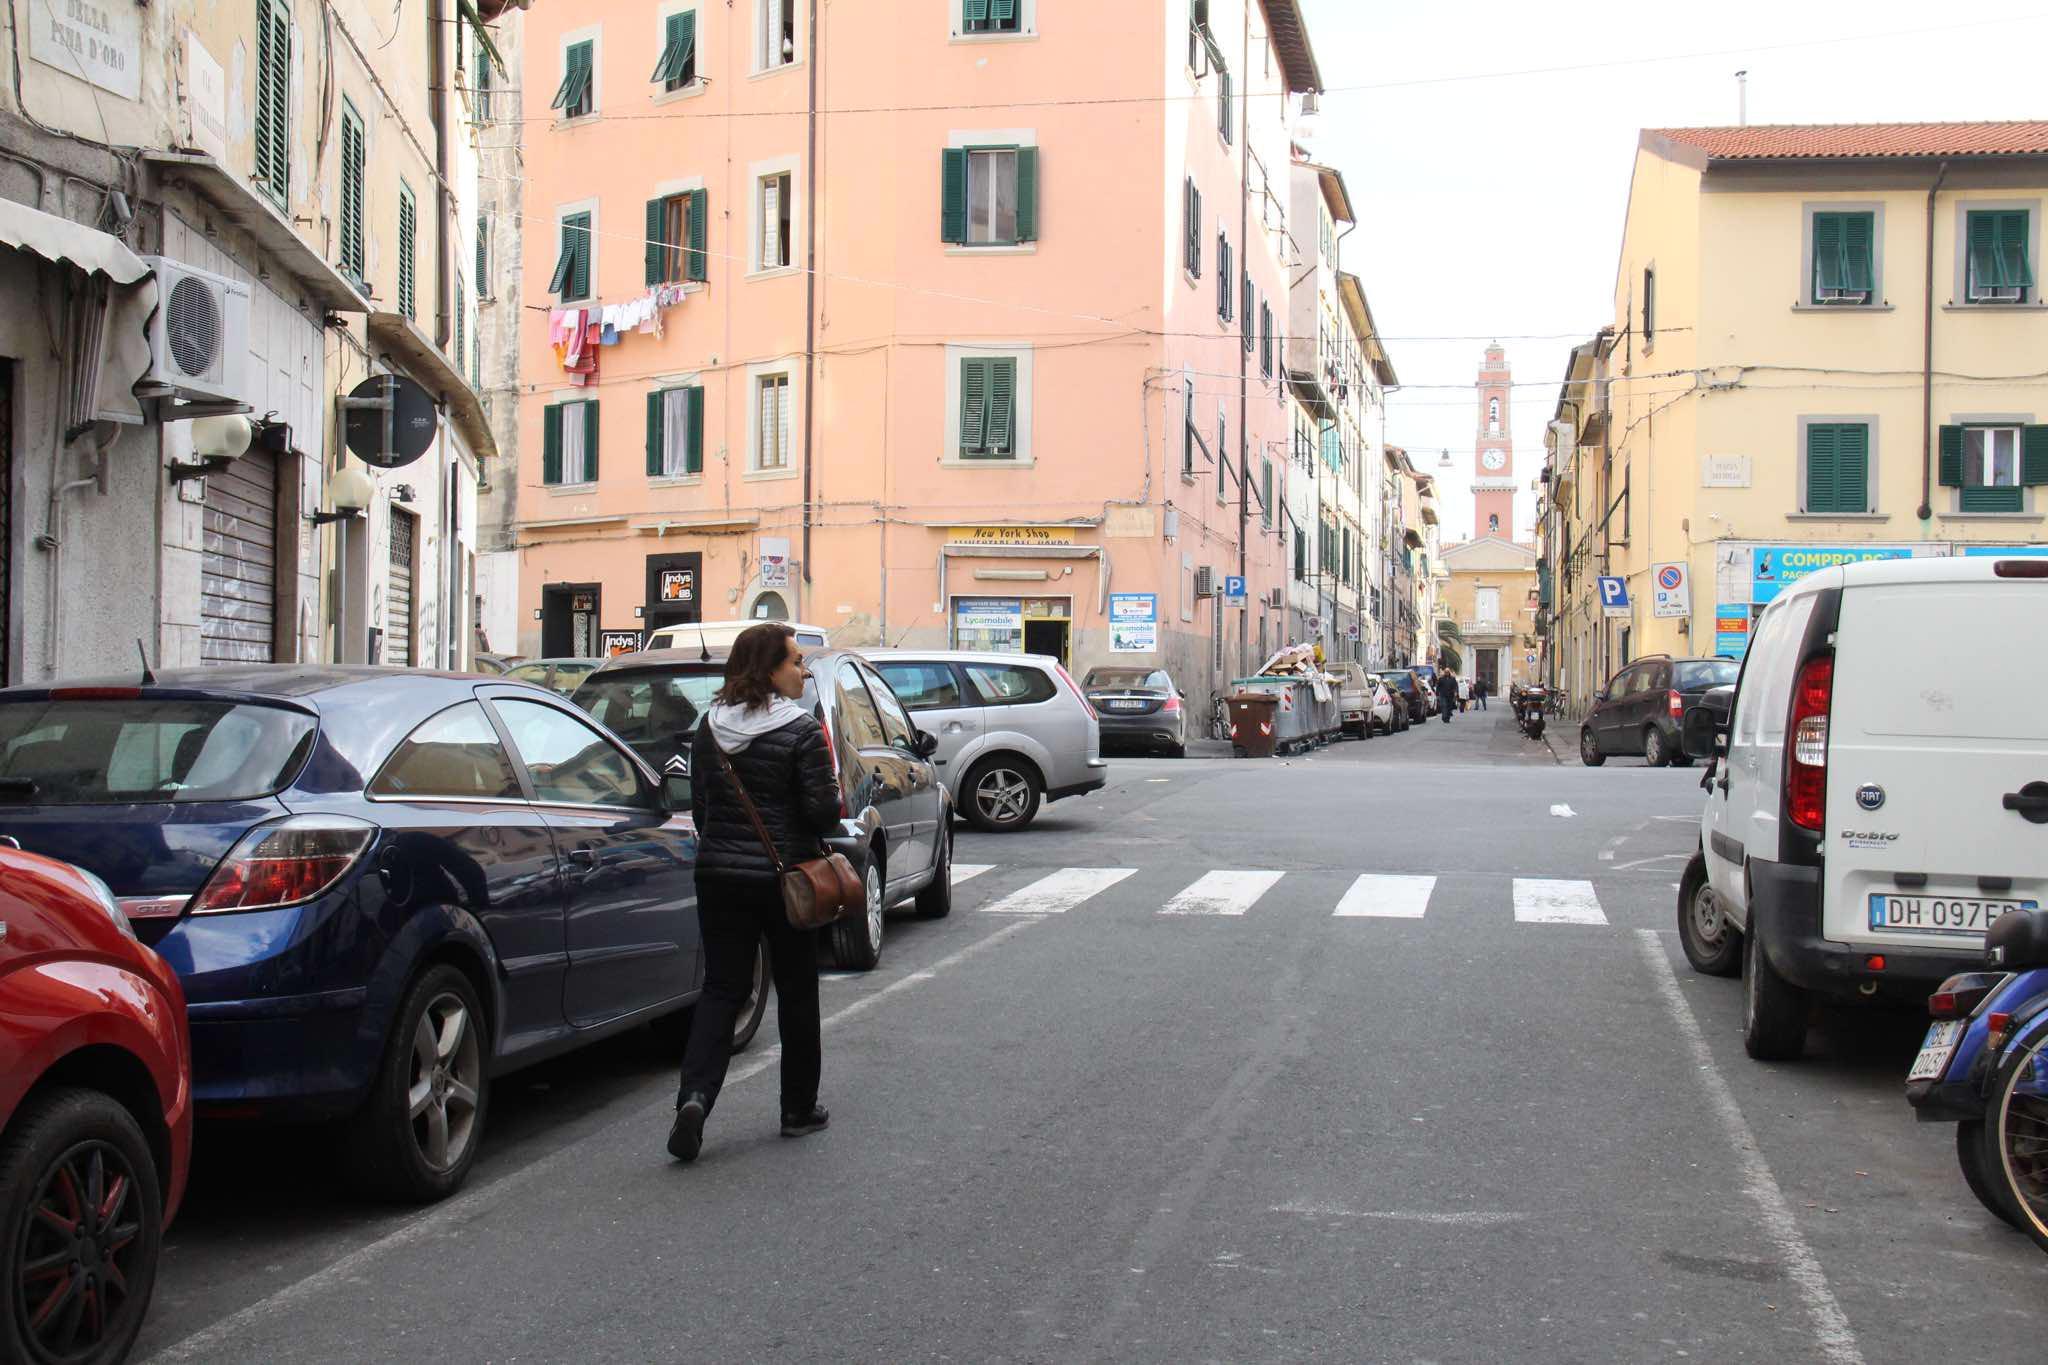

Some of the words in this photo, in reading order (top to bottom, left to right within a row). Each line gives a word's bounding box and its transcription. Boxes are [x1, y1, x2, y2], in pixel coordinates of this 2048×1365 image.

[973, 528, 994, 538] New
[1000, 528, 1021, 539] York
[1026, 528, 1050, 540] Shop
[1782, 553, 1857, 567] COMPRO
[1229, 579, 1241, 595] P
[1603, 580, 1621, 604] P
[1861, 791, 1880, 801] FIAT
